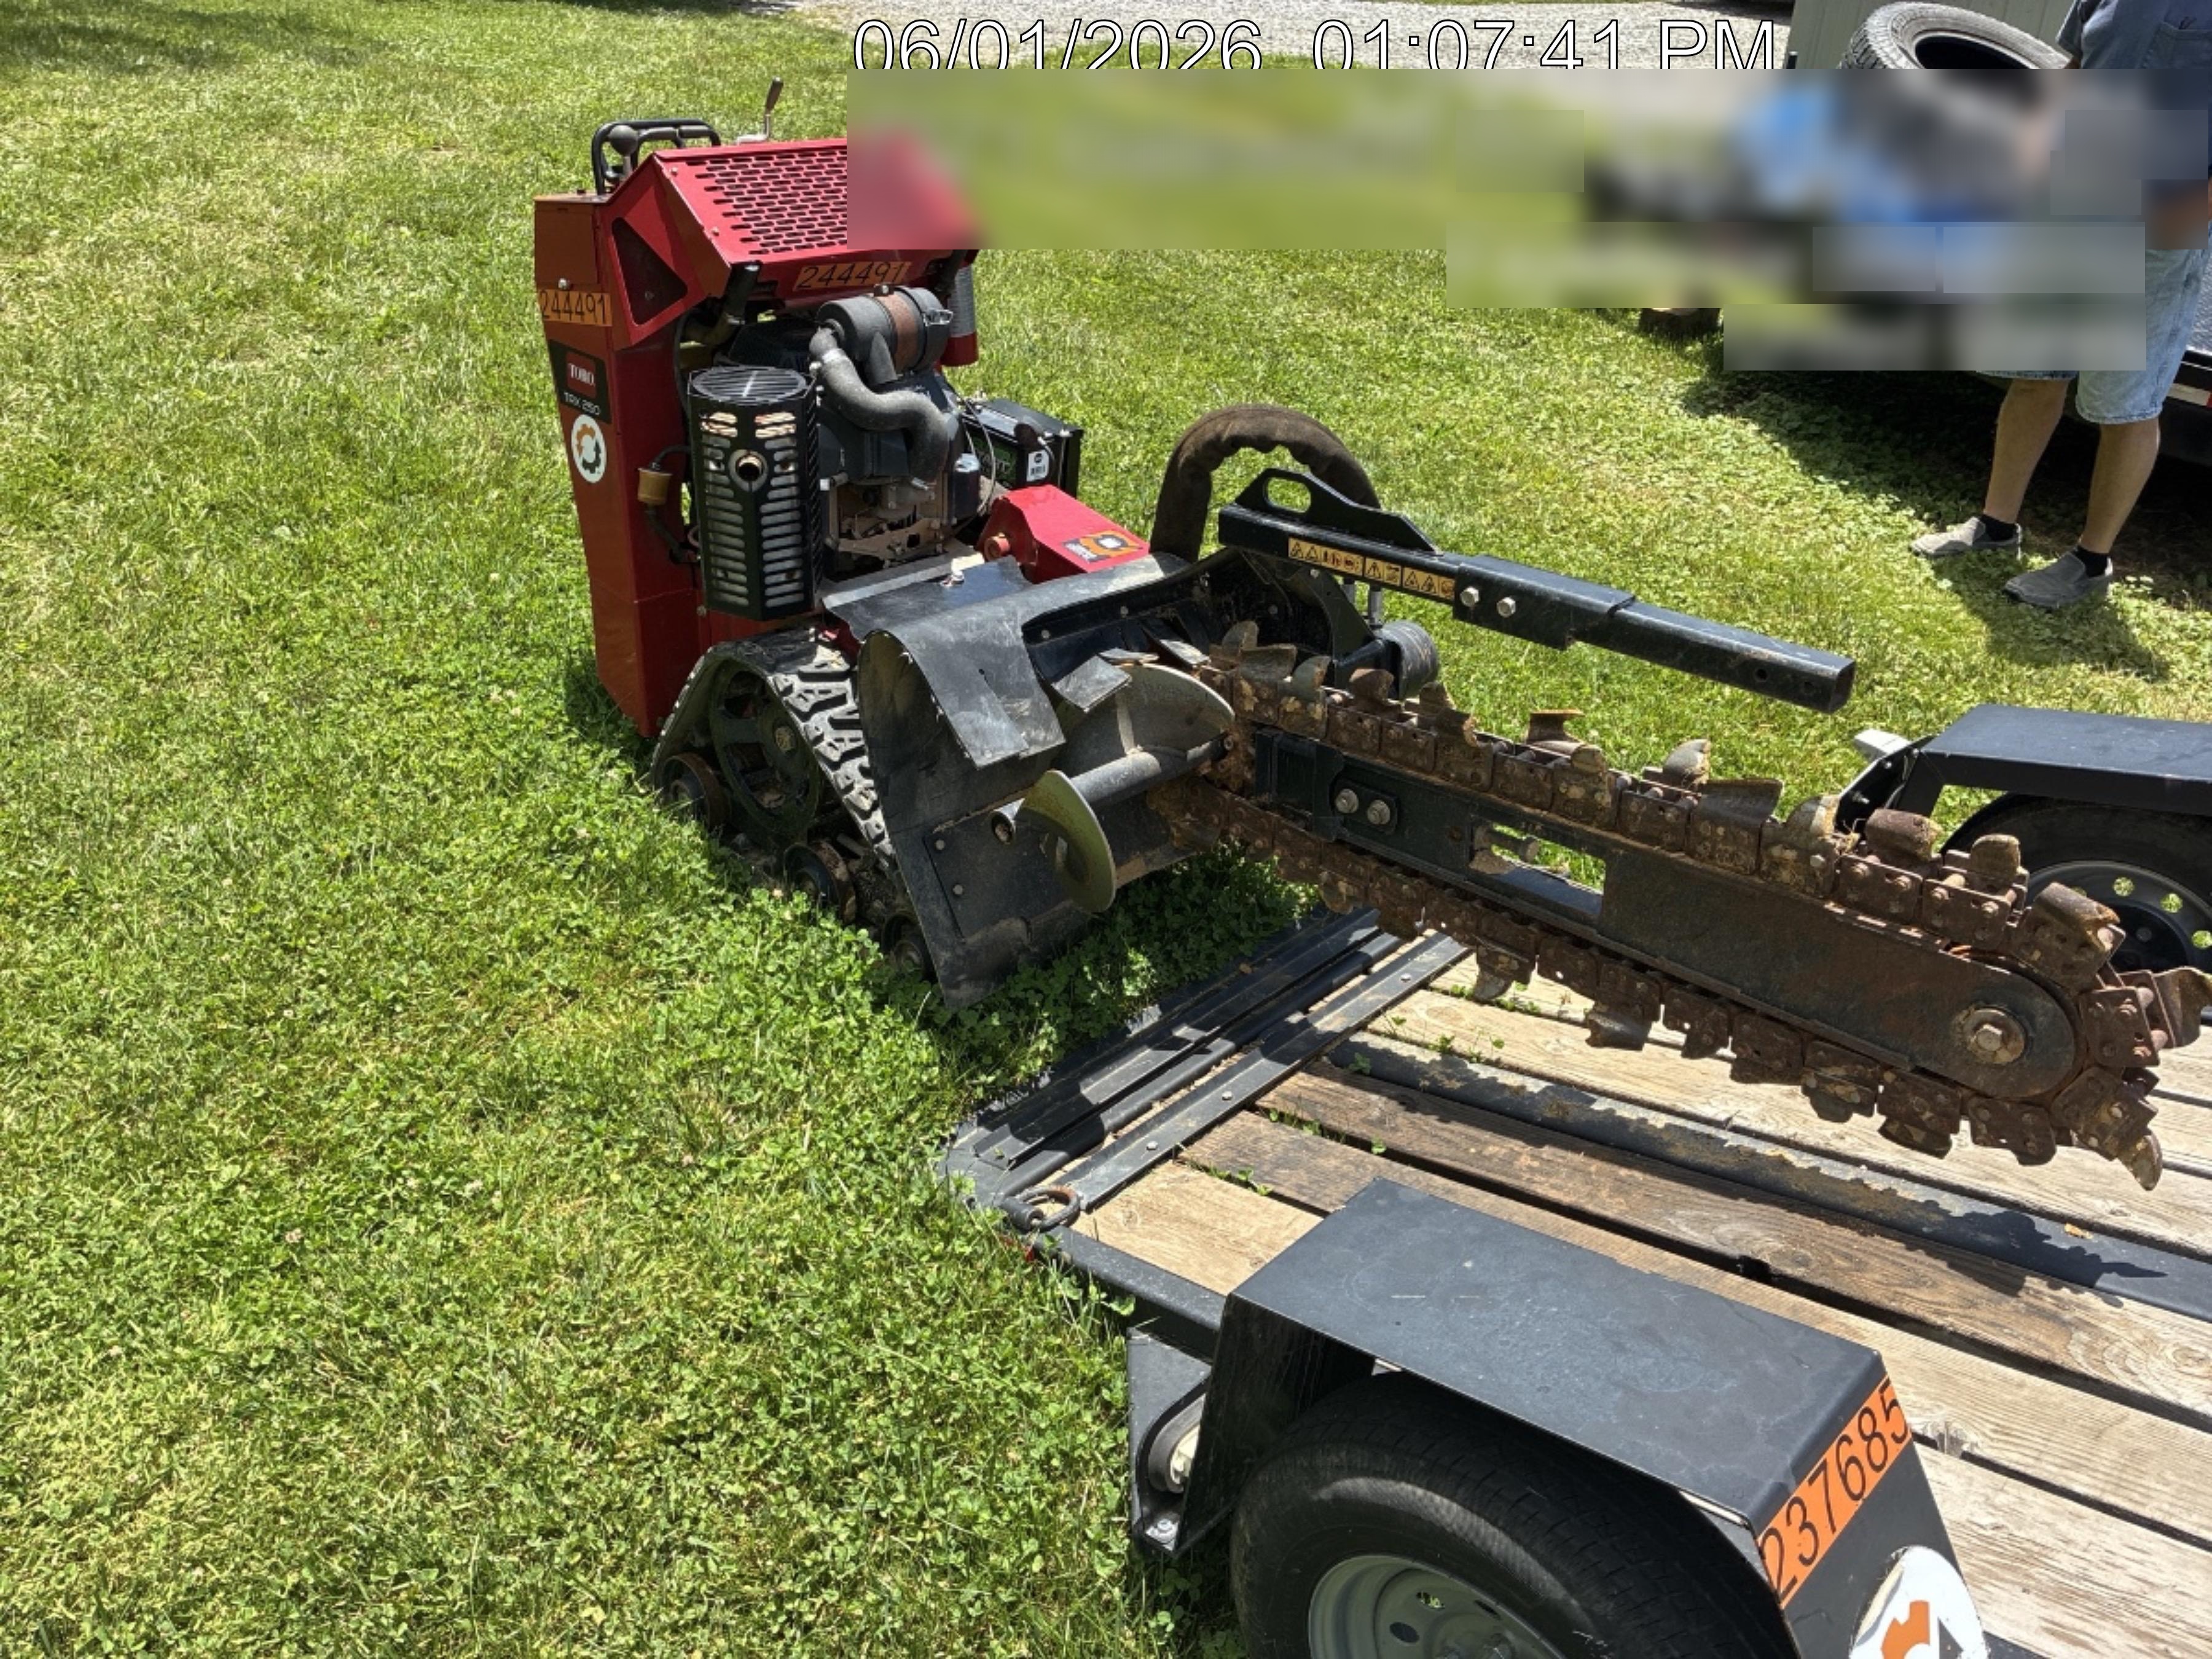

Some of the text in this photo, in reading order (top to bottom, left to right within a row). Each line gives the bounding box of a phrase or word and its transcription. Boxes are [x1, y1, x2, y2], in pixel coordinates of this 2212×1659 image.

[800, 262, 904, 288] 244491
[540, 291, 605, 323] 244491
[1760, 1379, 1907, 1599] 237685
